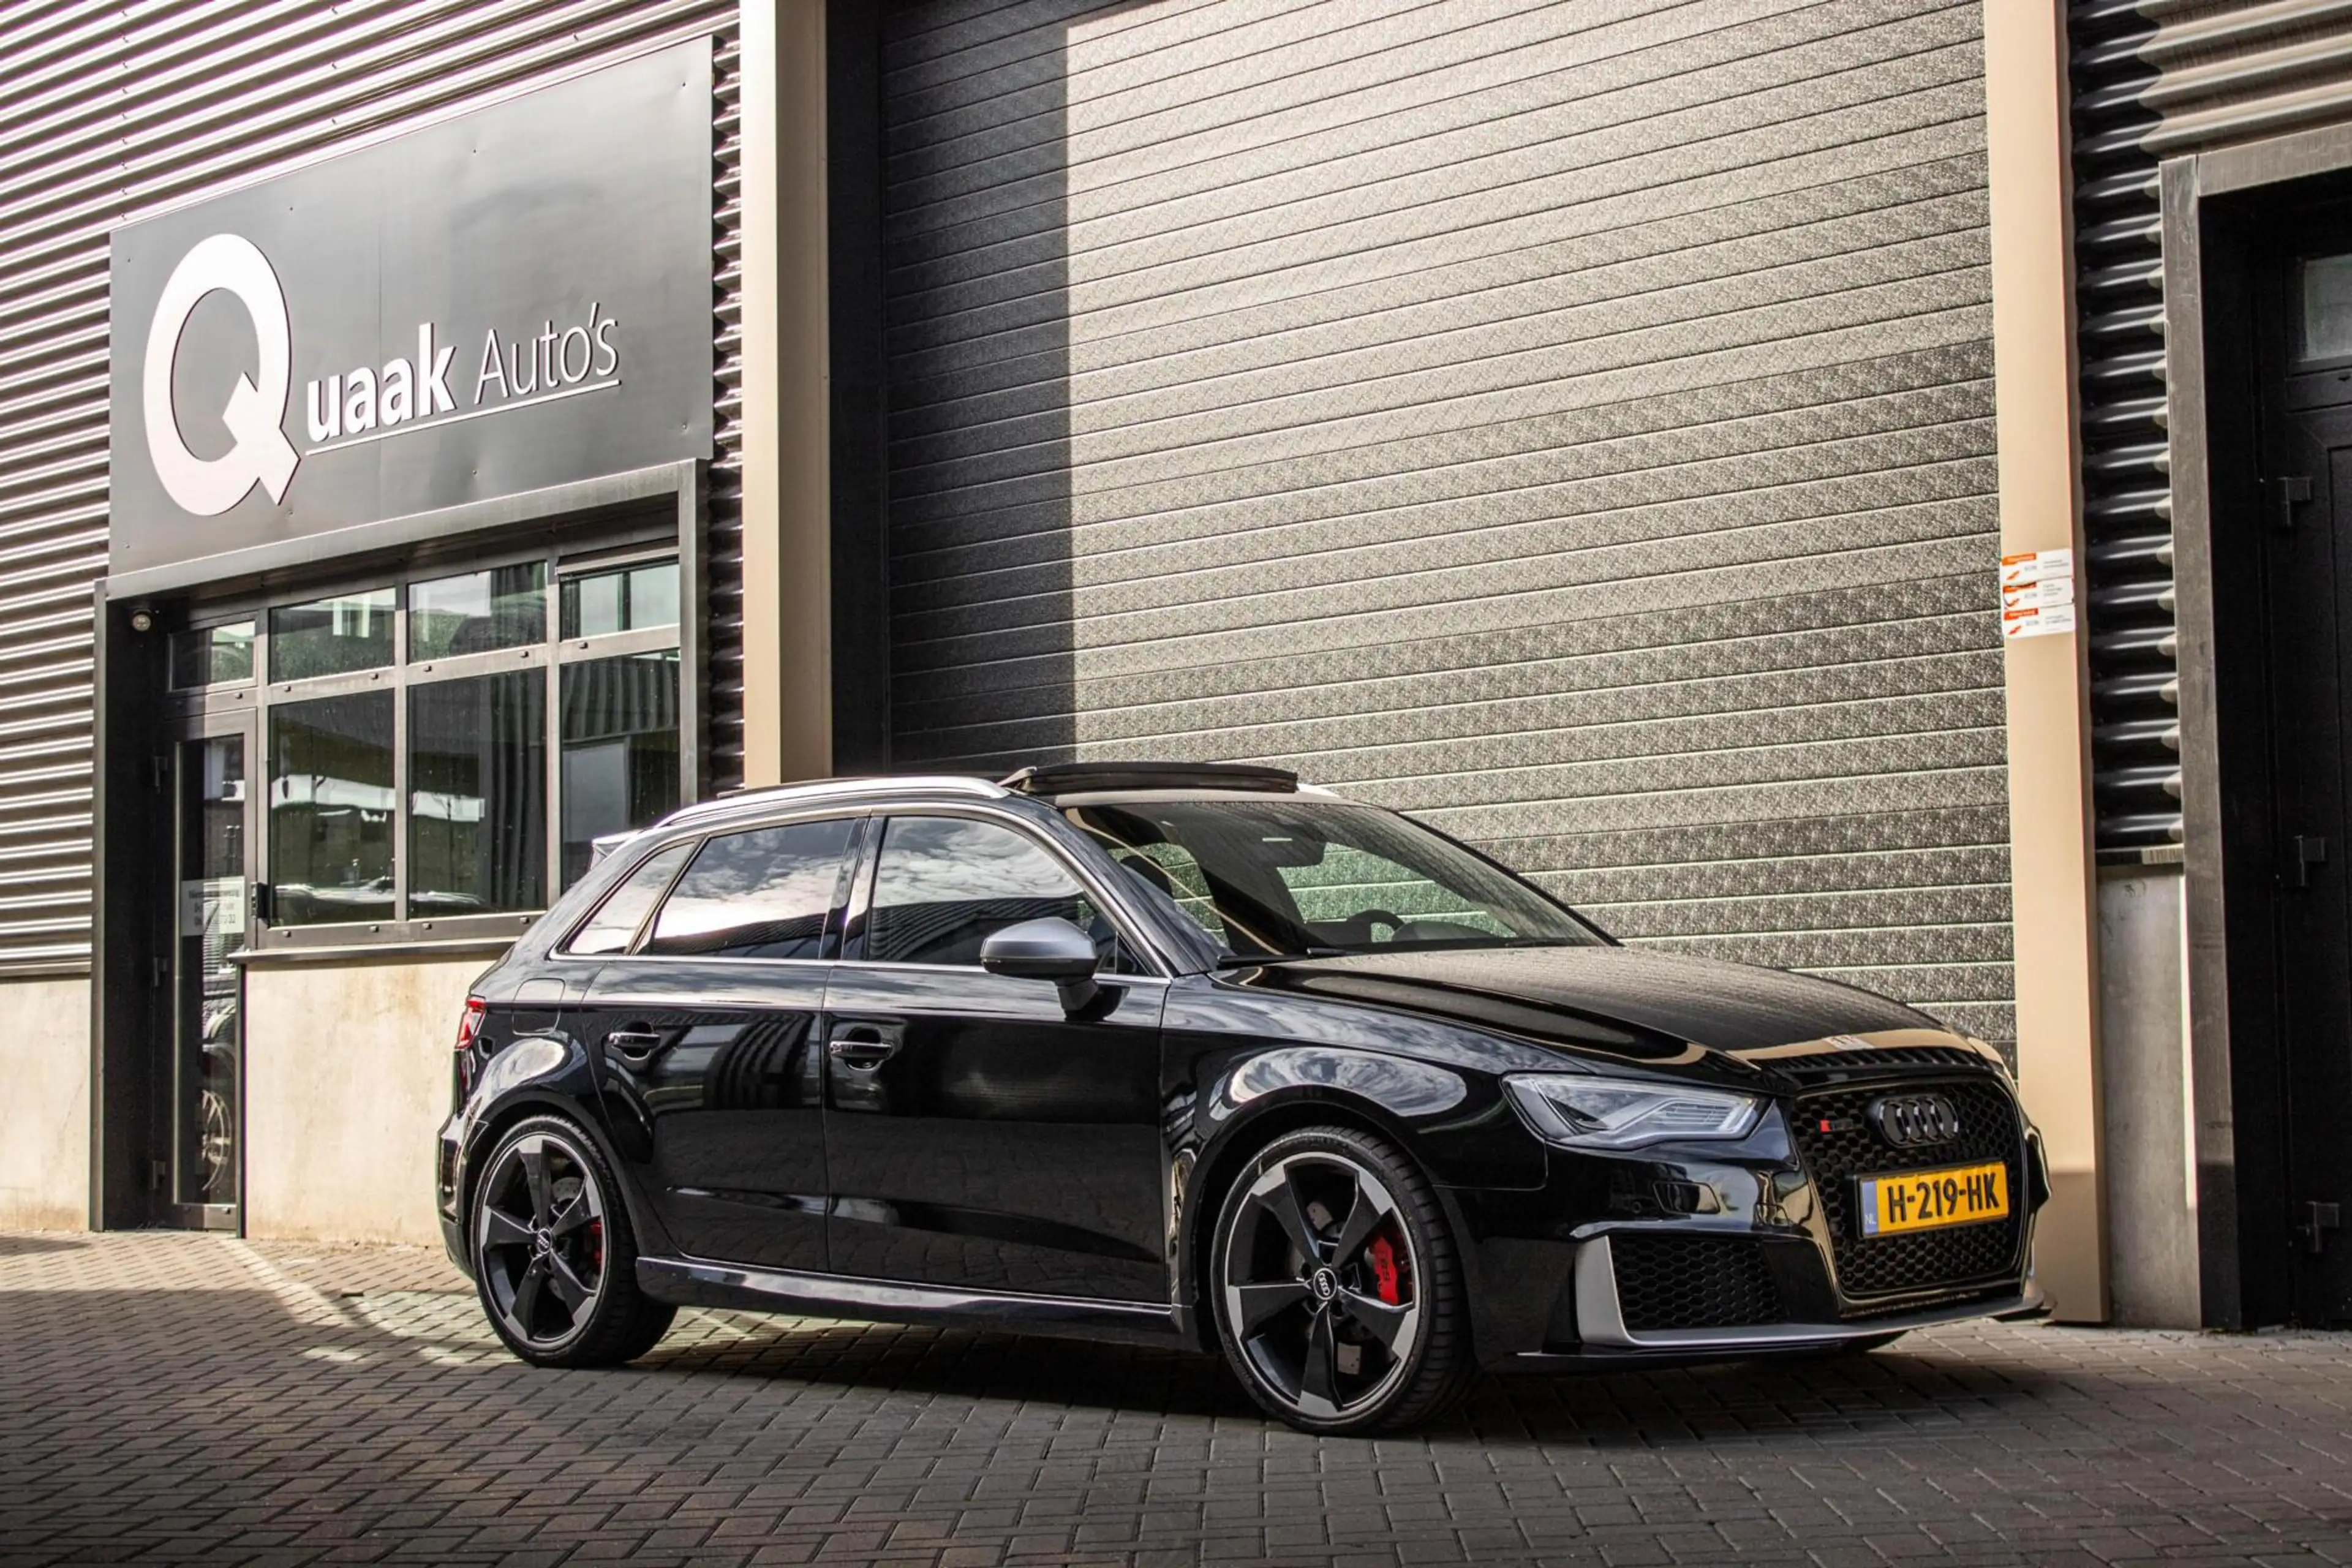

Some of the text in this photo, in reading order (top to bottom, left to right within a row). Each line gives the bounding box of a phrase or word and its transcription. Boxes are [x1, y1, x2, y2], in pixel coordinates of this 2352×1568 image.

[144, 233, 619, 515] Quaak Auto's
[1864, 1214, 1877, 1224] NL
[1887, 1172, 1999, 1223] H-219-HK
